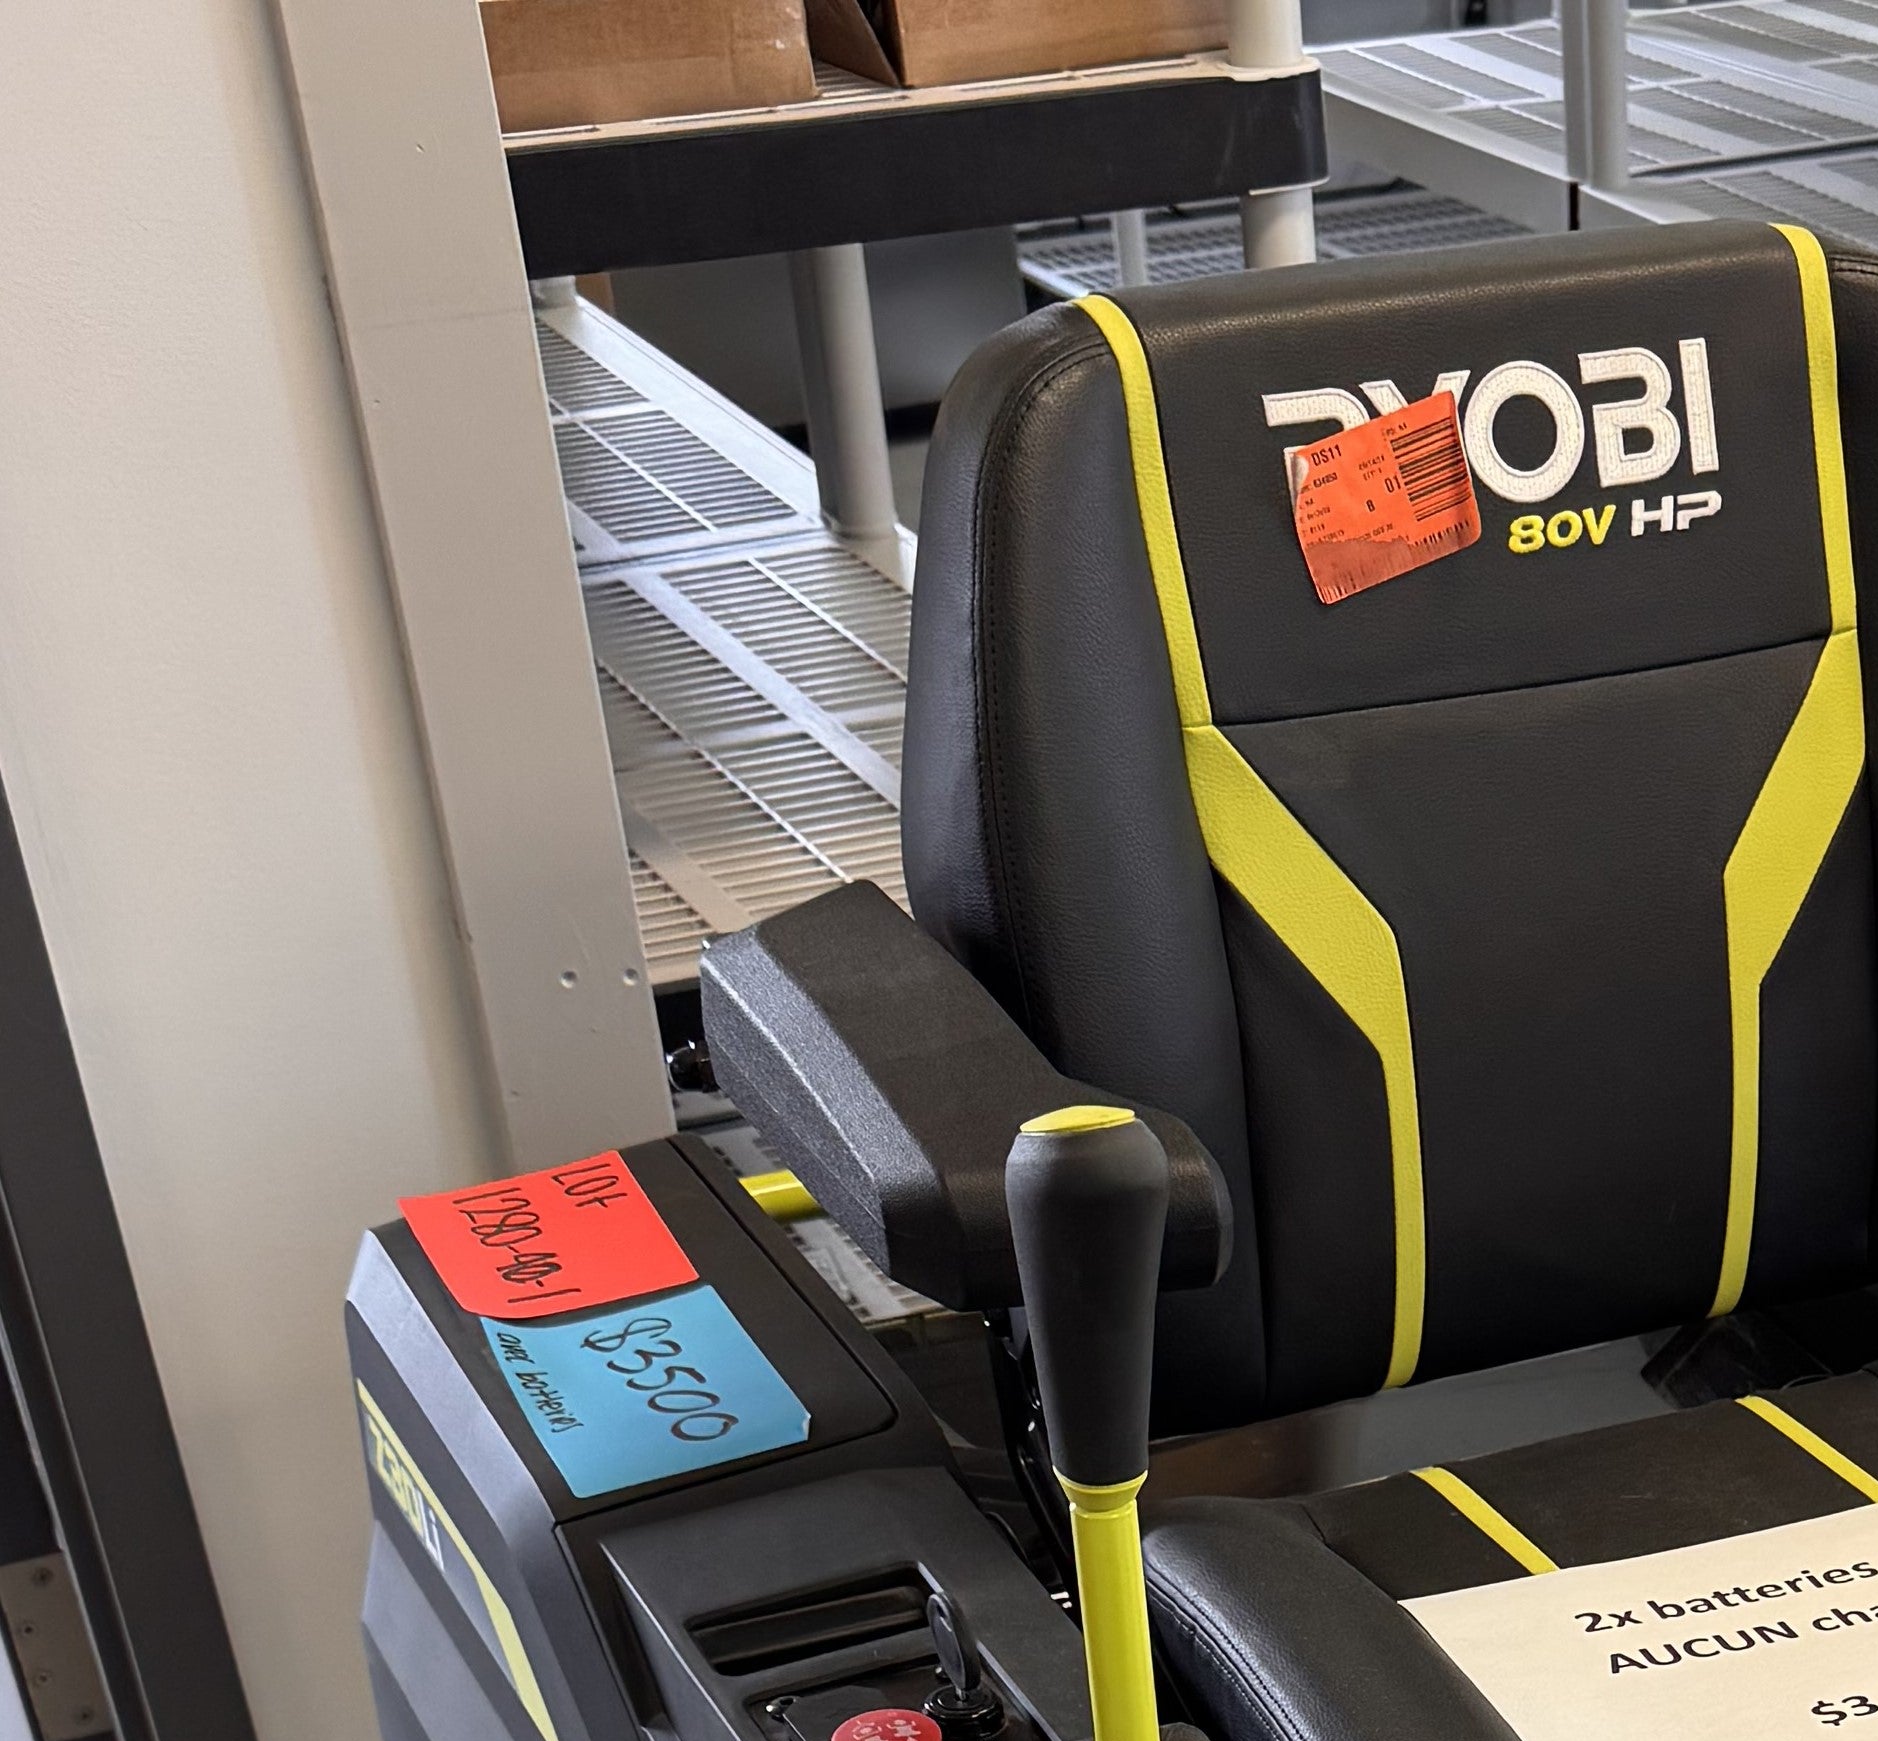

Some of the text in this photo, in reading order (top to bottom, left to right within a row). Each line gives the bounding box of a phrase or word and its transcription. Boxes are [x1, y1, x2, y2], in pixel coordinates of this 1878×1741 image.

[1508, 490, 1722, 554] 80V HP
[516, 1371, 585, 1434] batteries
[580, 1317, 739, 1441] $3500
[1573, 1607, 1646, 1633] 2x
[1608, 1620, 1800, 1675] AUCUN
